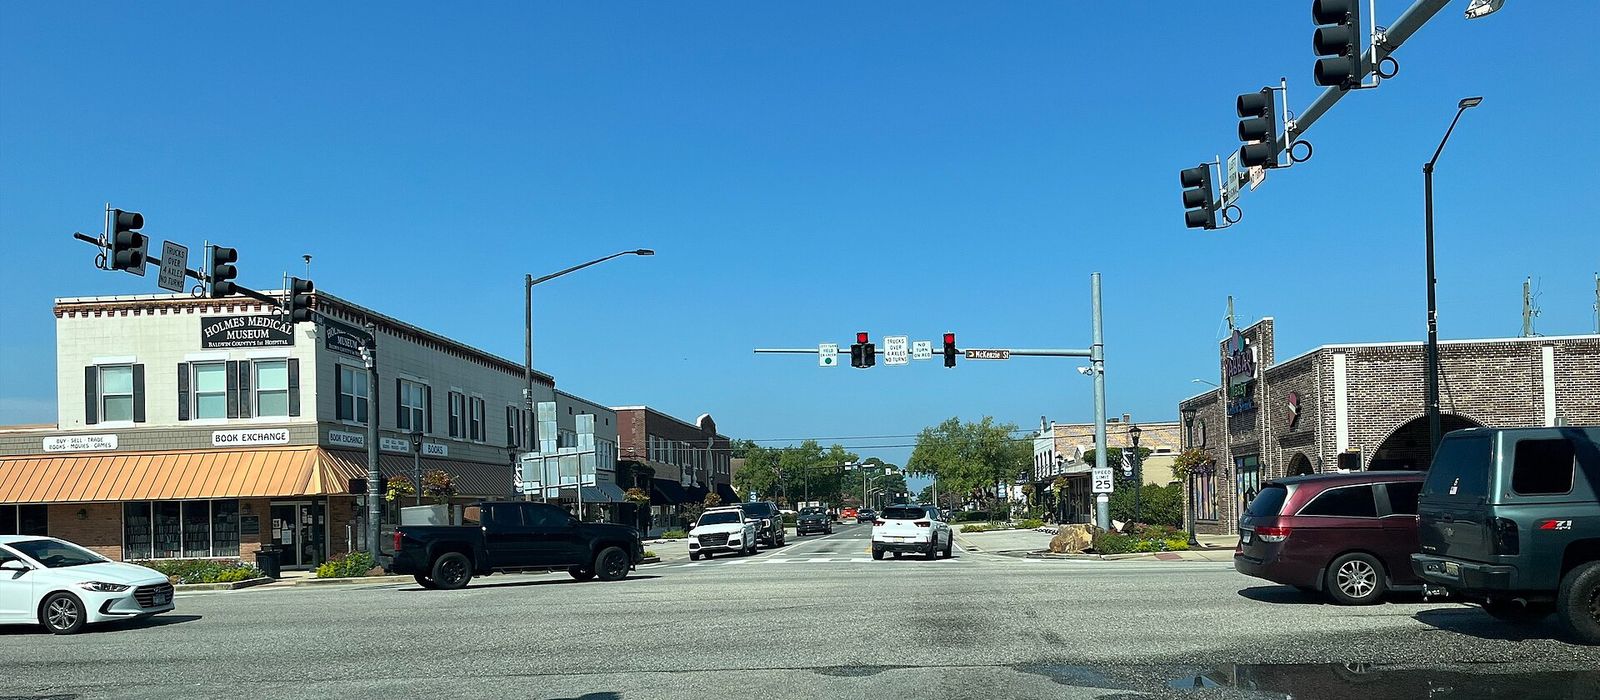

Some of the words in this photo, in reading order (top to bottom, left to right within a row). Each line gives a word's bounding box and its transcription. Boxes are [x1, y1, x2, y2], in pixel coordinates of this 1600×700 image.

[166, 246, 185, 259] TRUCKS
[168, 258, 181, 267] OVER
[168, 267, 183, 278] AXLES
[168, 278, 184, 288] TURNS
[203, 317, 245, 338] HOLMES
[248, 317, 293, 335] MEDICAL
[226, 329, 269, 340] MUSEUM
[215, 434, 238, 442] BOOK
[242, 432, 286, 441] EXCHANGE
[330, 433, 341, 441] BOOK
[342, 434, 363, 445] EXCHANGE
[427, 444, 443, 454] BOOKS
[1095, 480, 1111, 489] 25
